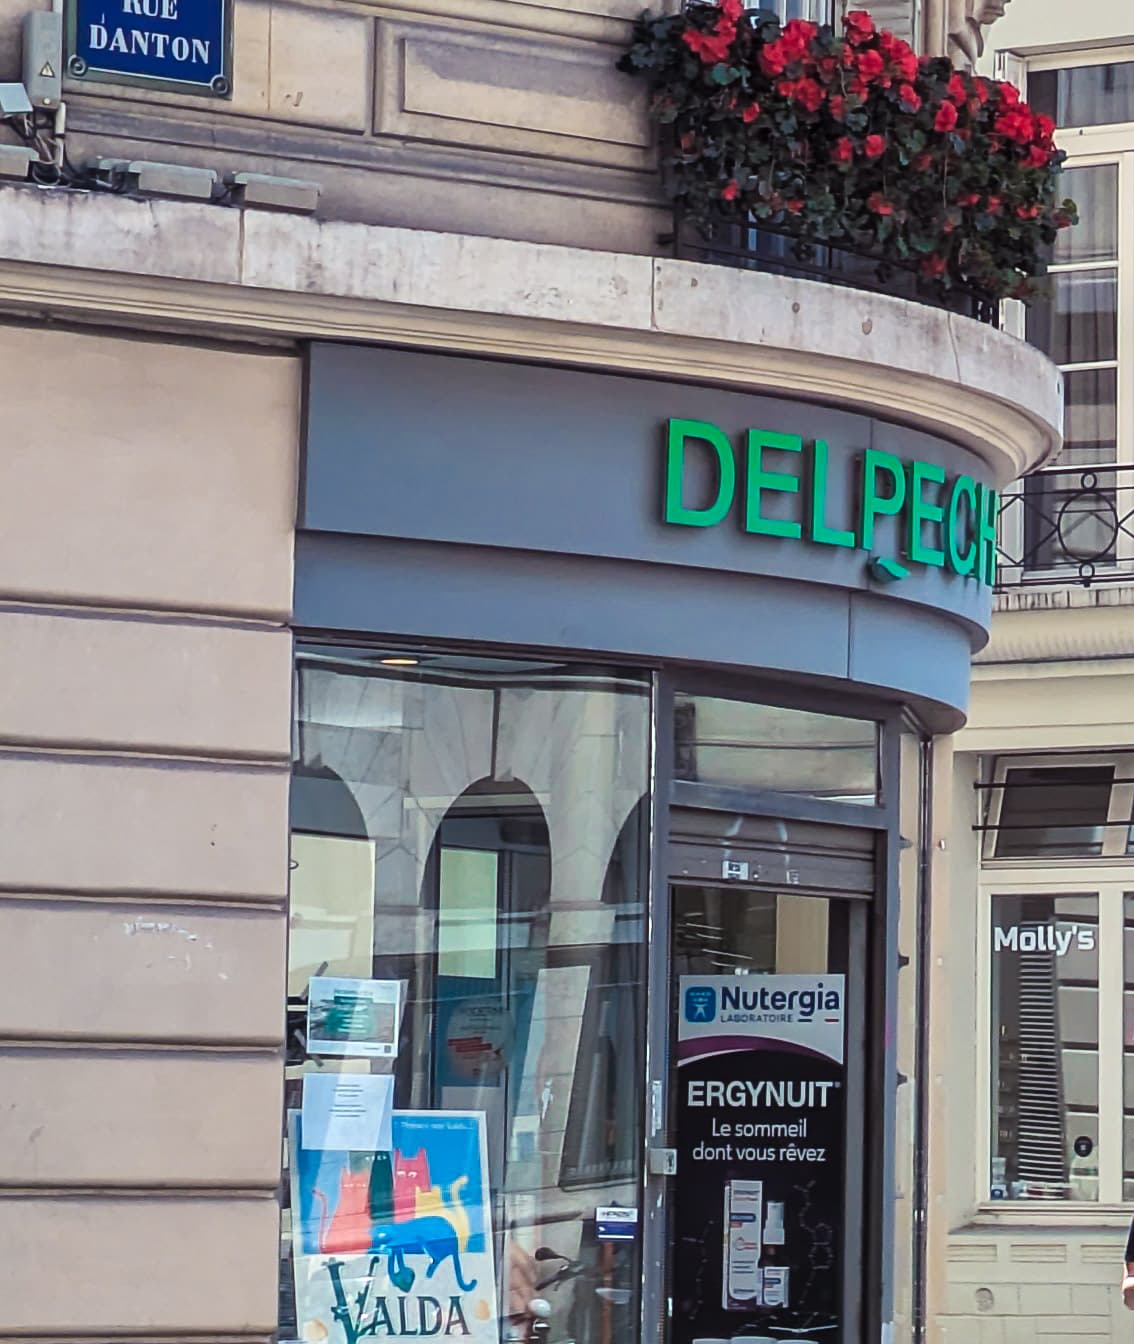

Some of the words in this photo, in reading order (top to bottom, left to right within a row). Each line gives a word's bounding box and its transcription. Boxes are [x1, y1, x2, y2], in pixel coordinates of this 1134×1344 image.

[89, 23, 211, 65] DANTON
[665, 417, 998, 587] DELPECH
[993, 924, 1095, 956] Molly's
[721, 982, 840, 1017] Nutergia
[720, 1014, 793, 1023] LABORATOIRE
[711, 1118, 732, 1137] Le
[735, 1118, 808, 1138] sommeil
[692, 1141, 733, 1161] dont
[736, 1148, 776, 1161] vous
[779, 1143, 826, 1162] rêvez
